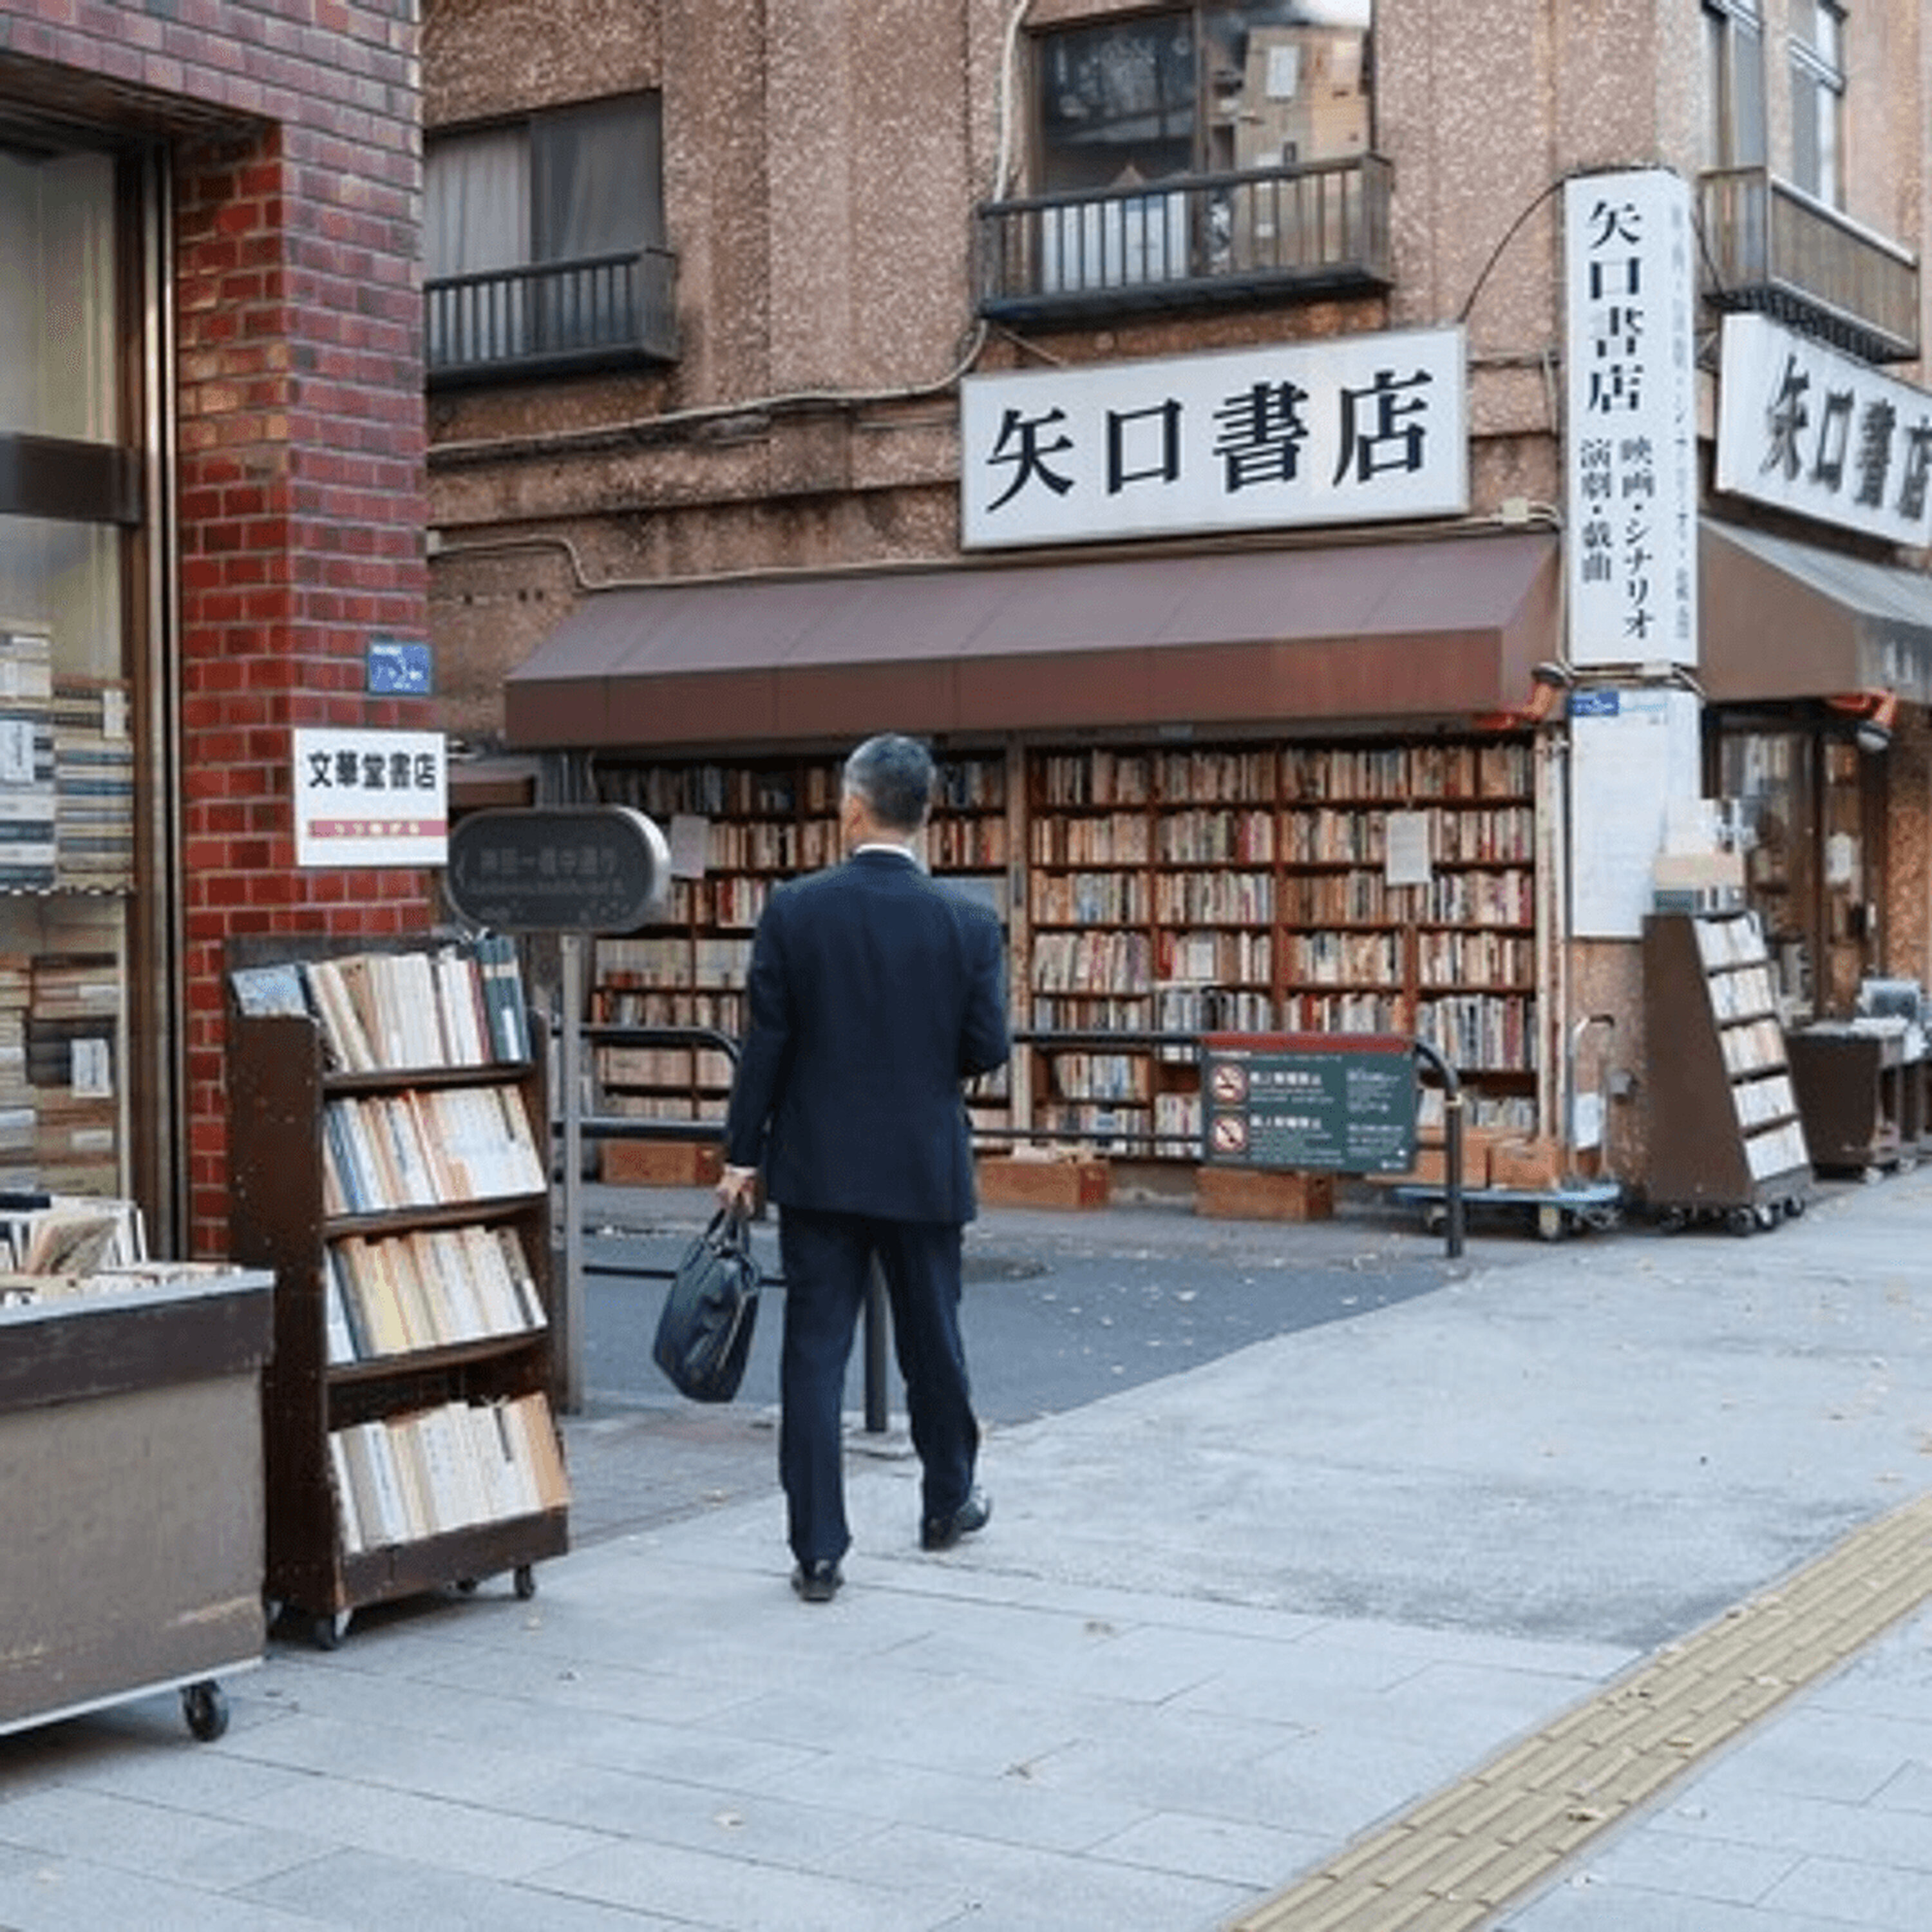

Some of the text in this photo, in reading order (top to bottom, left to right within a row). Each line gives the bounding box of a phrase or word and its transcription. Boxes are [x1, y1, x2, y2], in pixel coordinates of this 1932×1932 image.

[1589, 200, 1645, 415] 矢口書店
[985, 369, 1434, 513] 矢口書店
[1580, 437, 1614, 583] 演劇・戯曲
[1620, 434, 1655, 640] 映画・シナリオ
[307, 750, 437, 791] 文華堂書店
